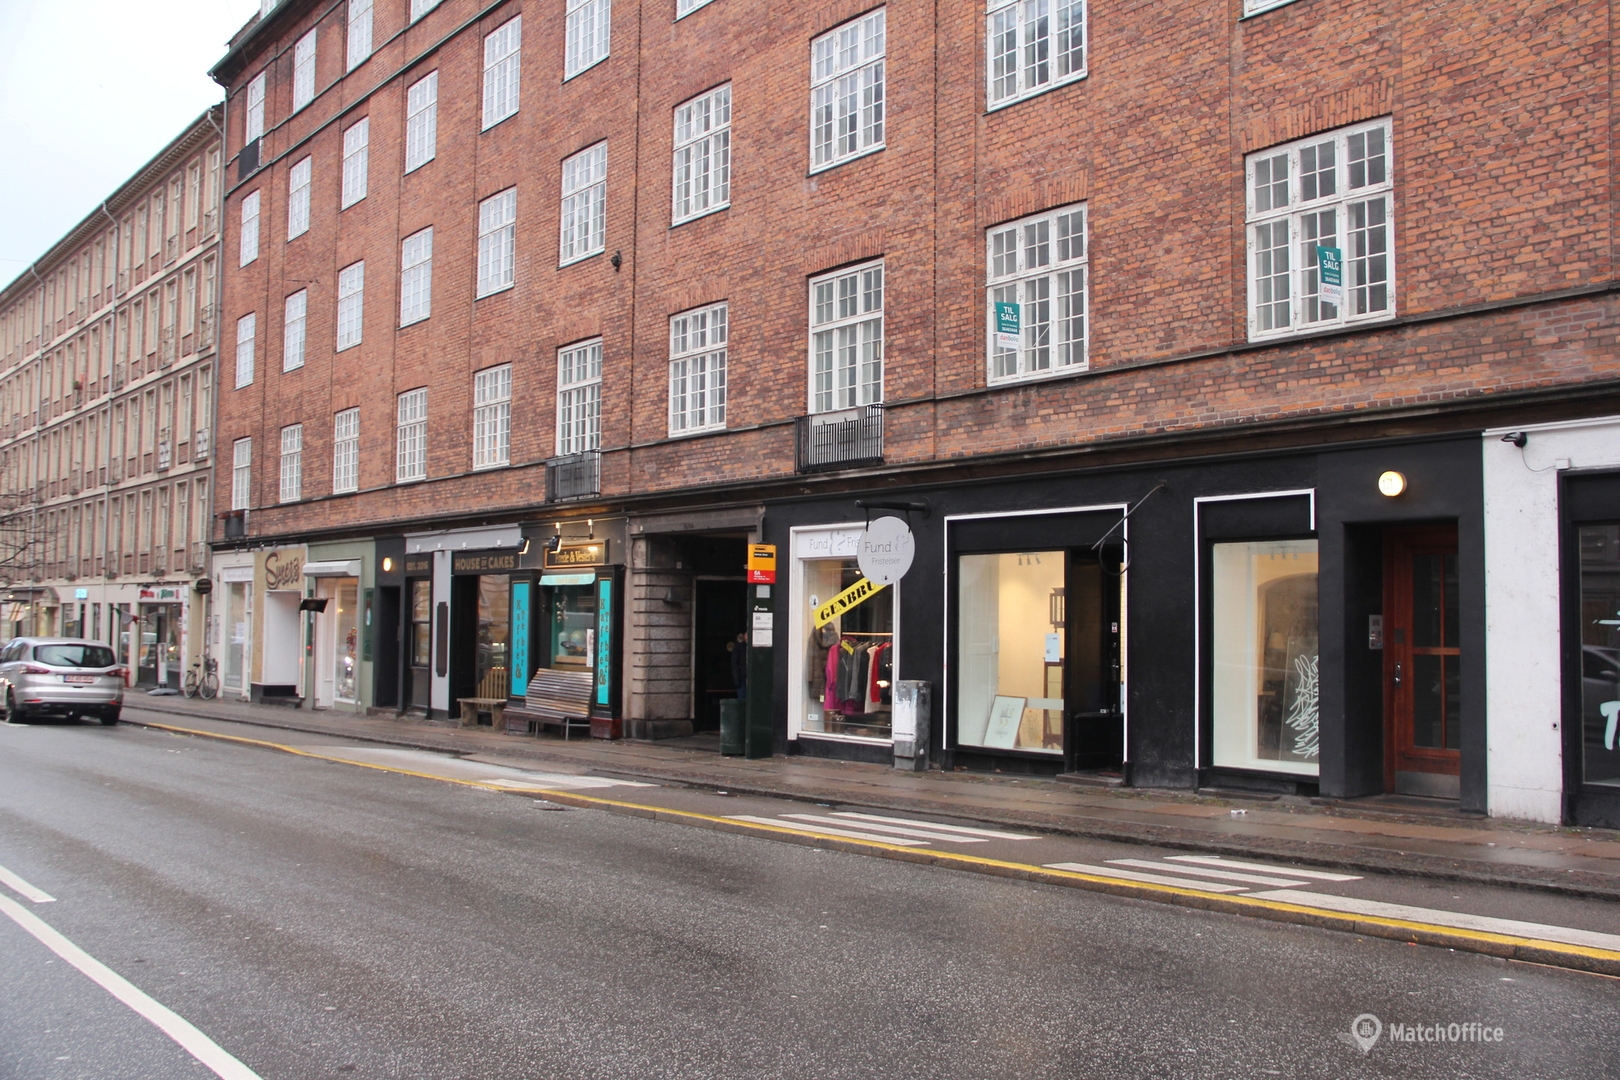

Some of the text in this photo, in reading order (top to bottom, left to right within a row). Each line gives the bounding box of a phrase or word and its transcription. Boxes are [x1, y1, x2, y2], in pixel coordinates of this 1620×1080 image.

[1325, 251, 1335, 261] TIL
[1323, 260, 1339, 270] SALG
[1003, 306, 1014, 314] TIL
[1001, 313, 1017, 322] SALG
[809, 538, 828, 550] Fund
[864, 541, 892, 553] Fund
[455, 558, 480, 571] HOUSE
[488, 556, 515, 569] CAKES
[871, 557, 901, 565] Fristelser
[820, 580, 876, 621] GENBRU
